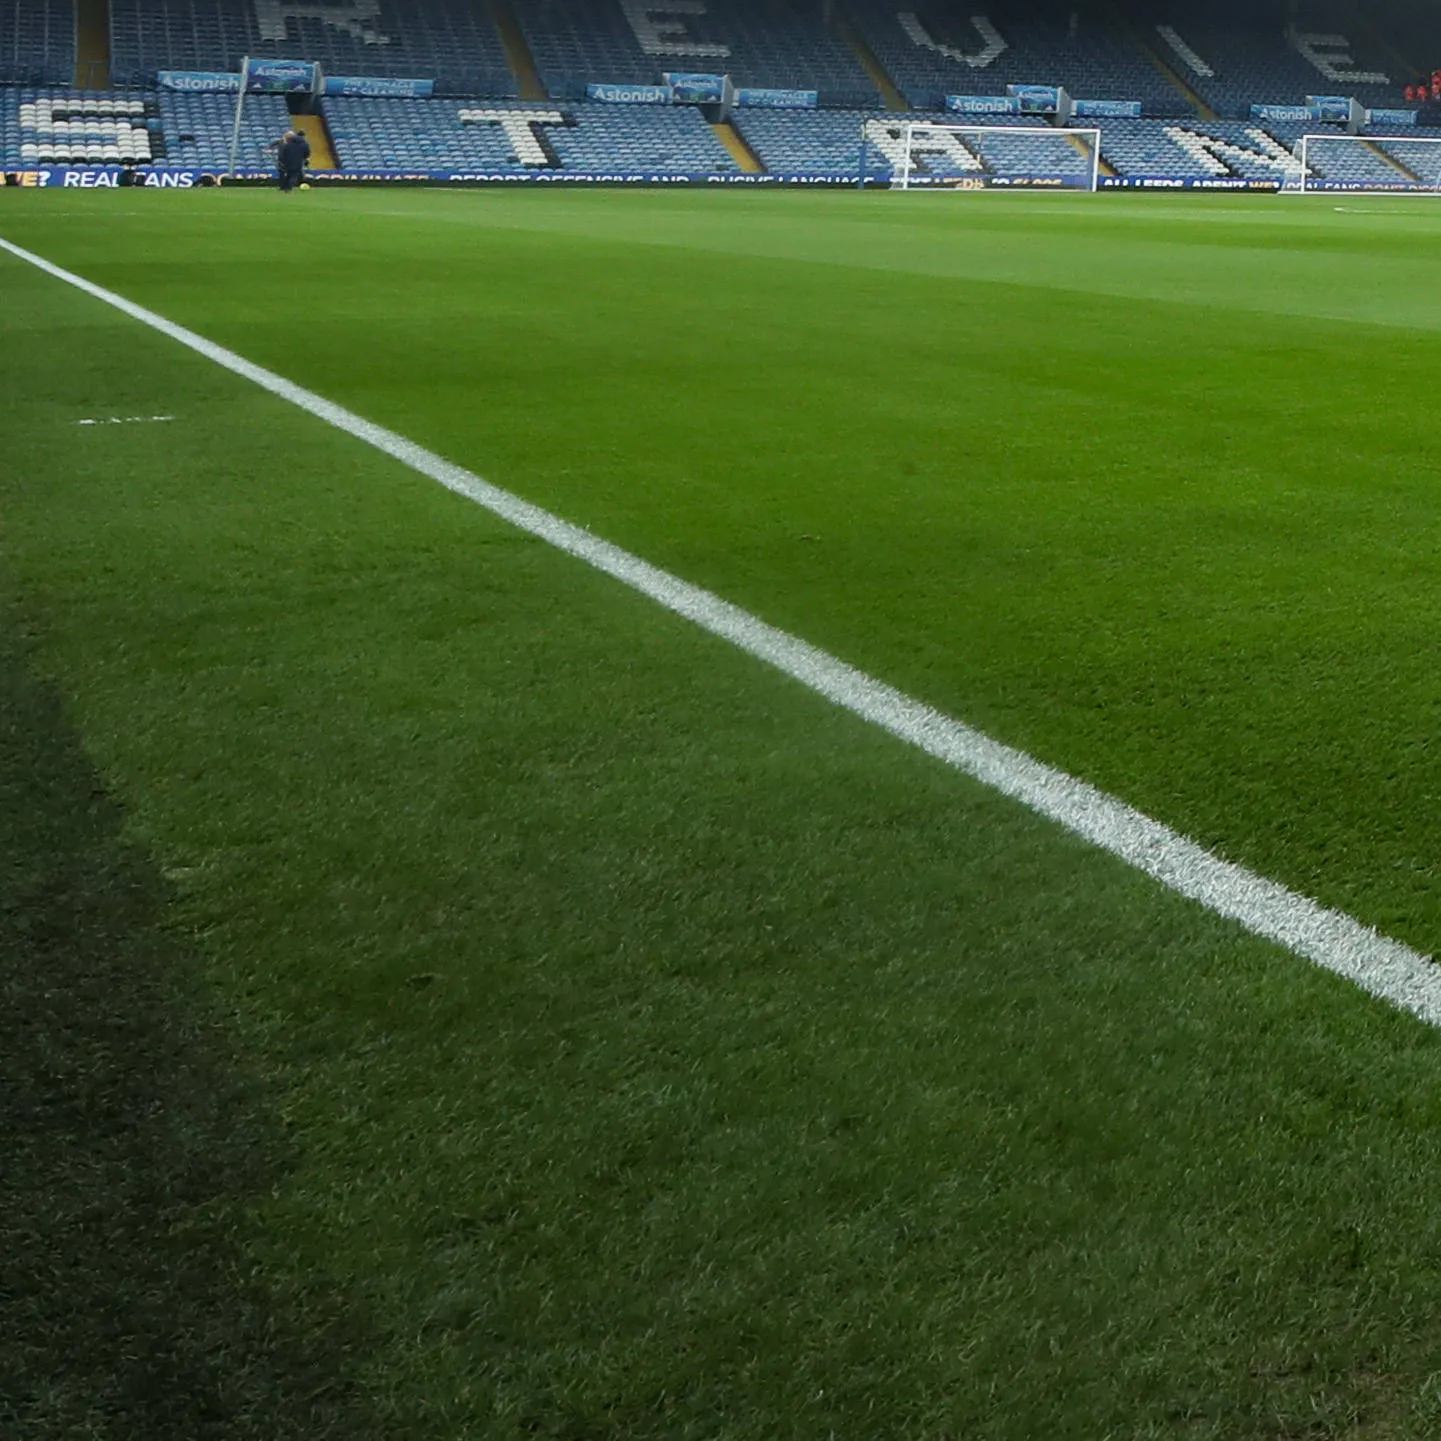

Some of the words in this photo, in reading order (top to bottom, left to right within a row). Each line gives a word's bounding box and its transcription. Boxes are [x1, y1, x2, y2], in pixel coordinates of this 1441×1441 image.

[162, 72, 238, 91] Astonish
[593, 87, 665, 103] Astonish
[952, 99, 1012, 112] Astonish
